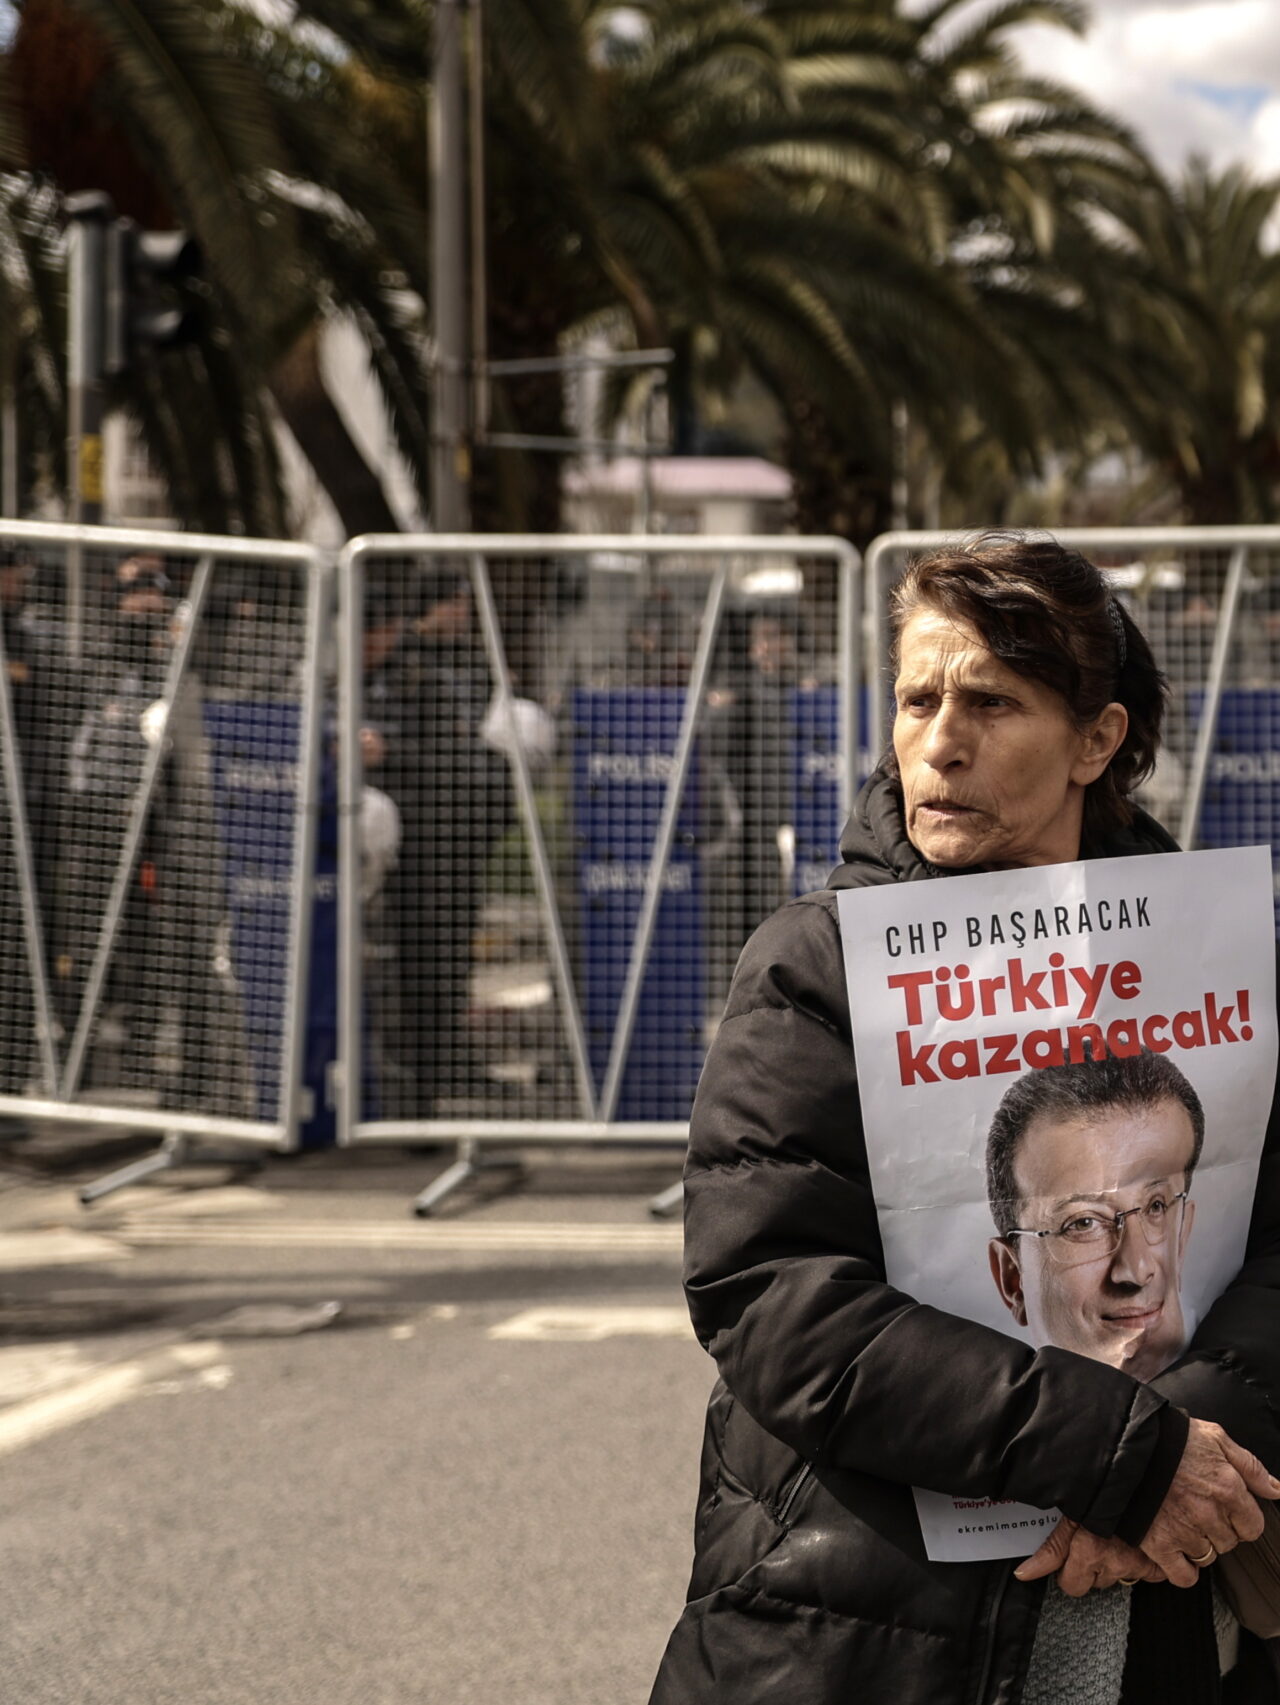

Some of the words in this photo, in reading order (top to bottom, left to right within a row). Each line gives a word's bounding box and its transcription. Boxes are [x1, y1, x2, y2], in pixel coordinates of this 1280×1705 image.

[886, 920, 948, 957] CHP
[966, 896, 1152, 949] BAŞARACAK
[887, 952, 1142, 1026] Türkiye
[895, 989, 1254, 1087] kazanacak!
[958, 1516, 1058, 1533] ekremimamoglu
